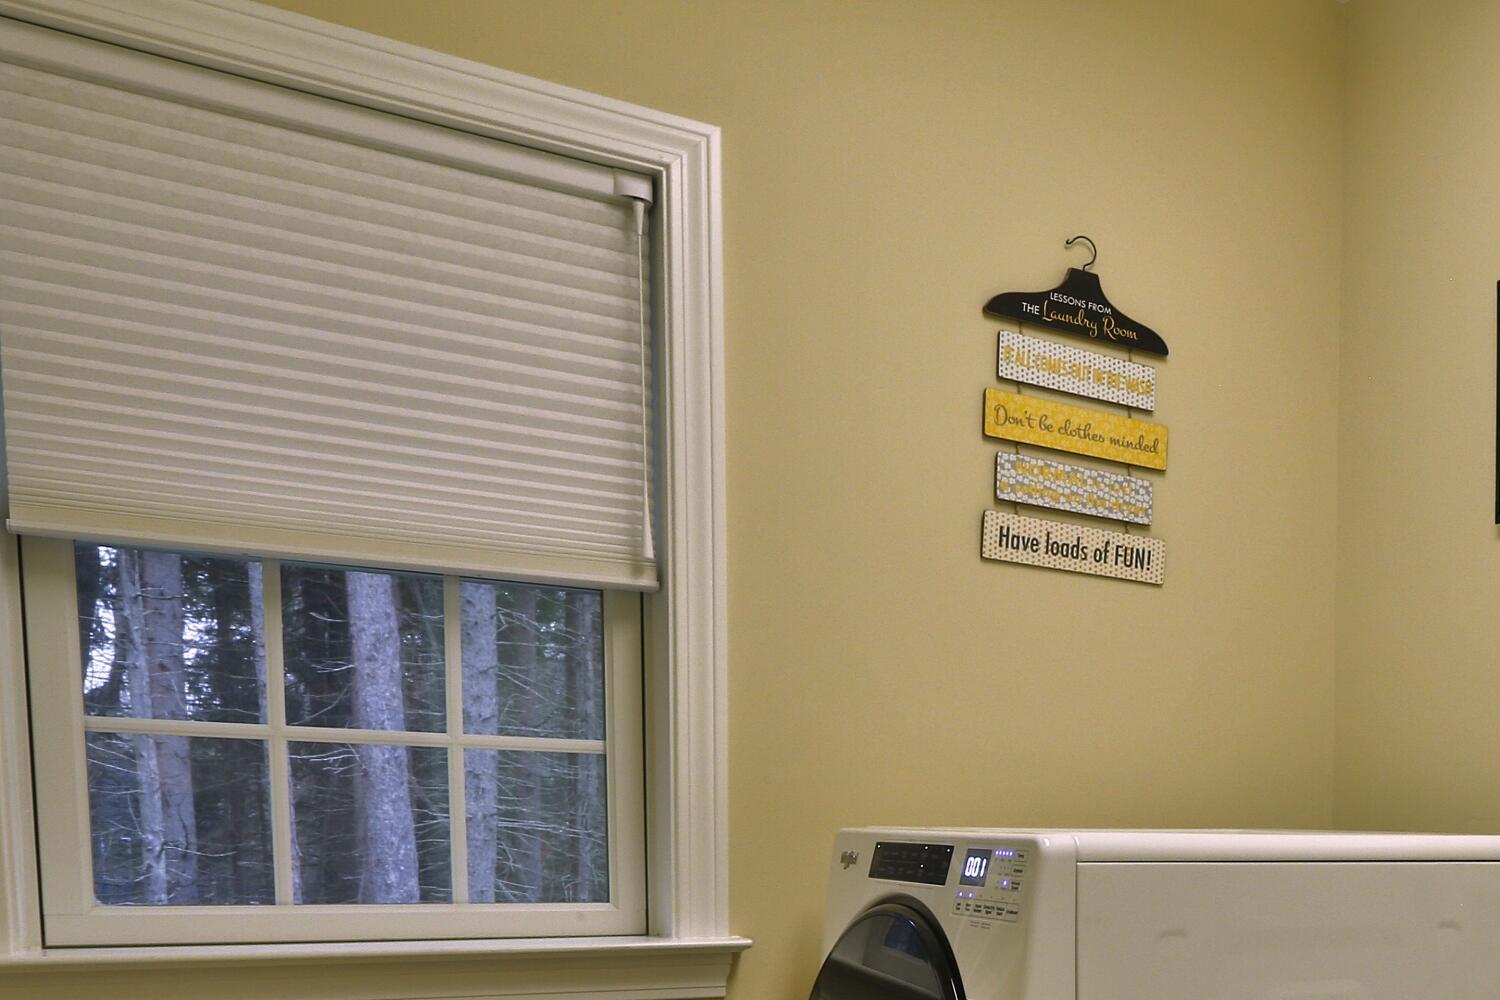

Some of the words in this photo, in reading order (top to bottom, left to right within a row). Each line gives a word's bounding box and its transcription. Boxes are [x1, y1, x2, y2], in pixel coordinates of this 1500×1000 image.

[1022, 301, 1040, 315] THE
[1042, 299, 1098, 338] Laundry
[1102, 315, 1138, 340] Room
[1050, 291, 1086, 309] LESSONS
[1088, 301, 1112, 315] FROM
[993, 403, 1037, 429] Don't
[1038, 414, 1054, 432] be
[1057, 419, 1105, 443] clothes
[1110, 434, 1160, 454] minded
[998, 525, 1040, 553] Have
[1045, 532, 1088, 561] loads
[1093, 540, 1110, 564] of
[1114, 544, 1152, 571] FUN!
